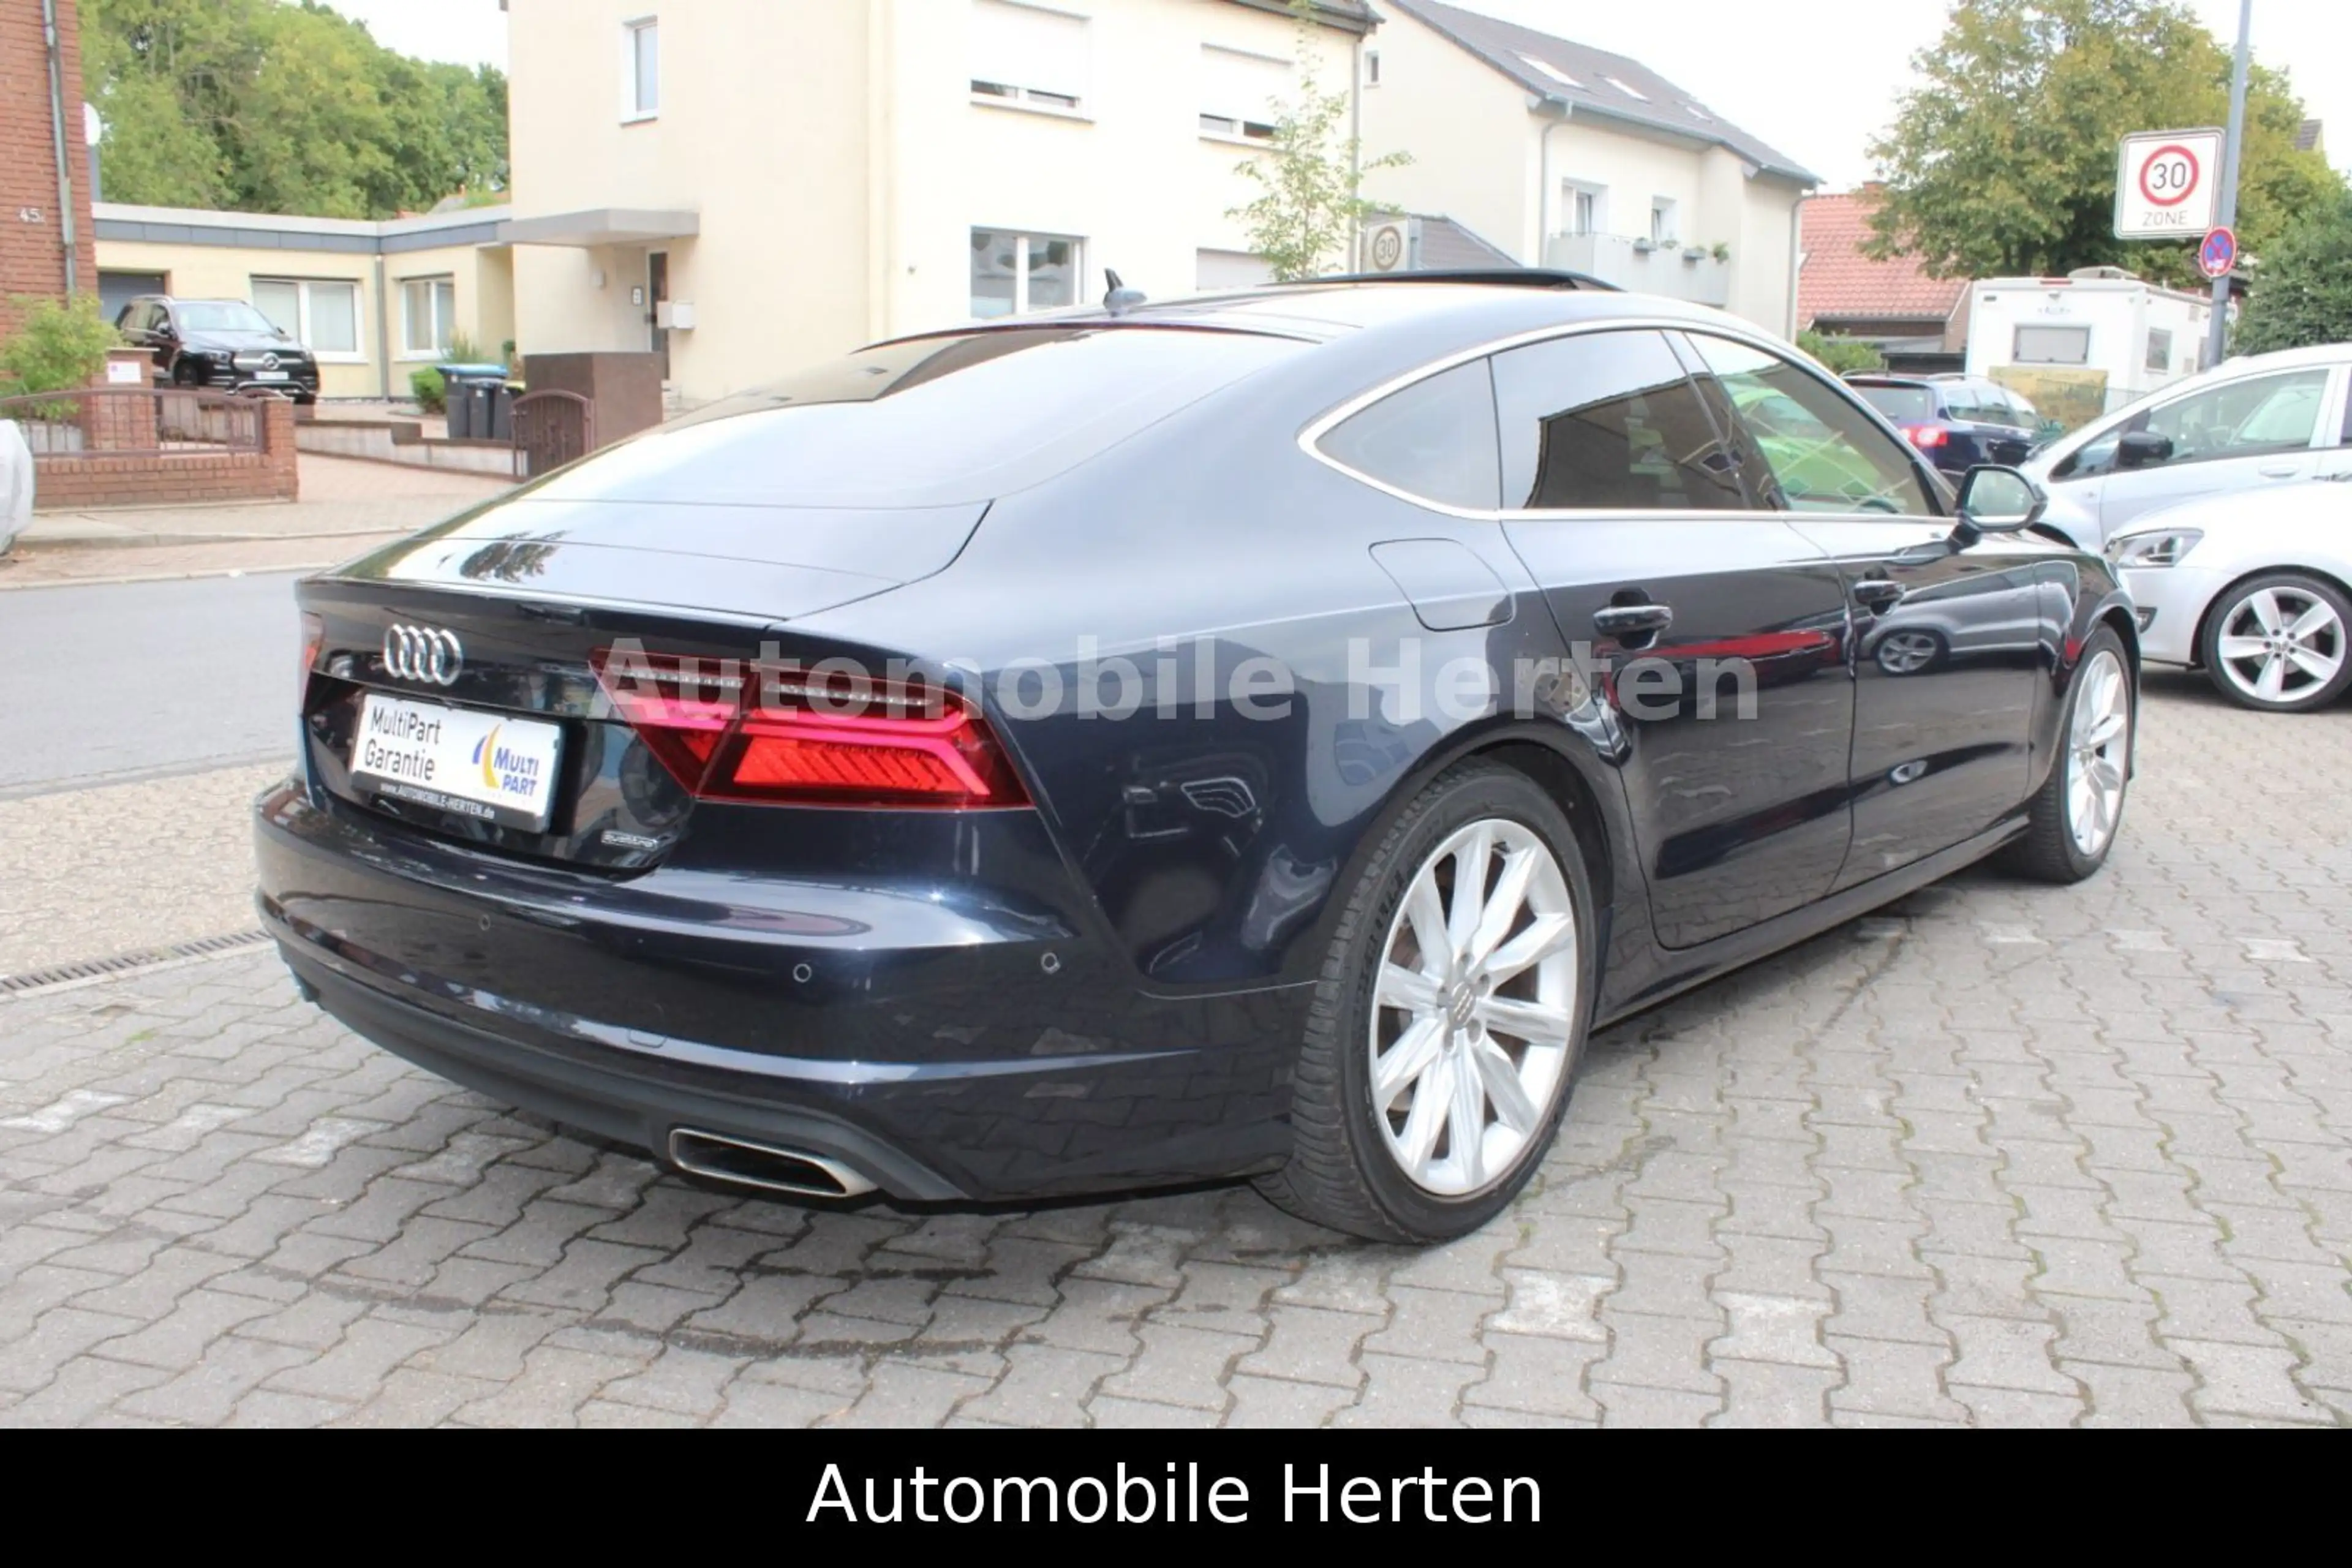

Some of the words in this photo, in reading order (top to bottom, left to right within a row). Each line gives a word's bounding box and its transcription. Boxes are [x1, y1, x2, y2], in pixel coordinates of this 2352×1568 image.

[2152, 161, 2186, 190] 30
[2142, 210, 2188, 227] ZONE
[1378, 237, 1395, 260] 30
[370, 706, 441, 745] MultiPart
[364, 738, 435, 781] Garantie
[494, 747, 539, 777] MULTI
[502, 774, 537, 797] PART
